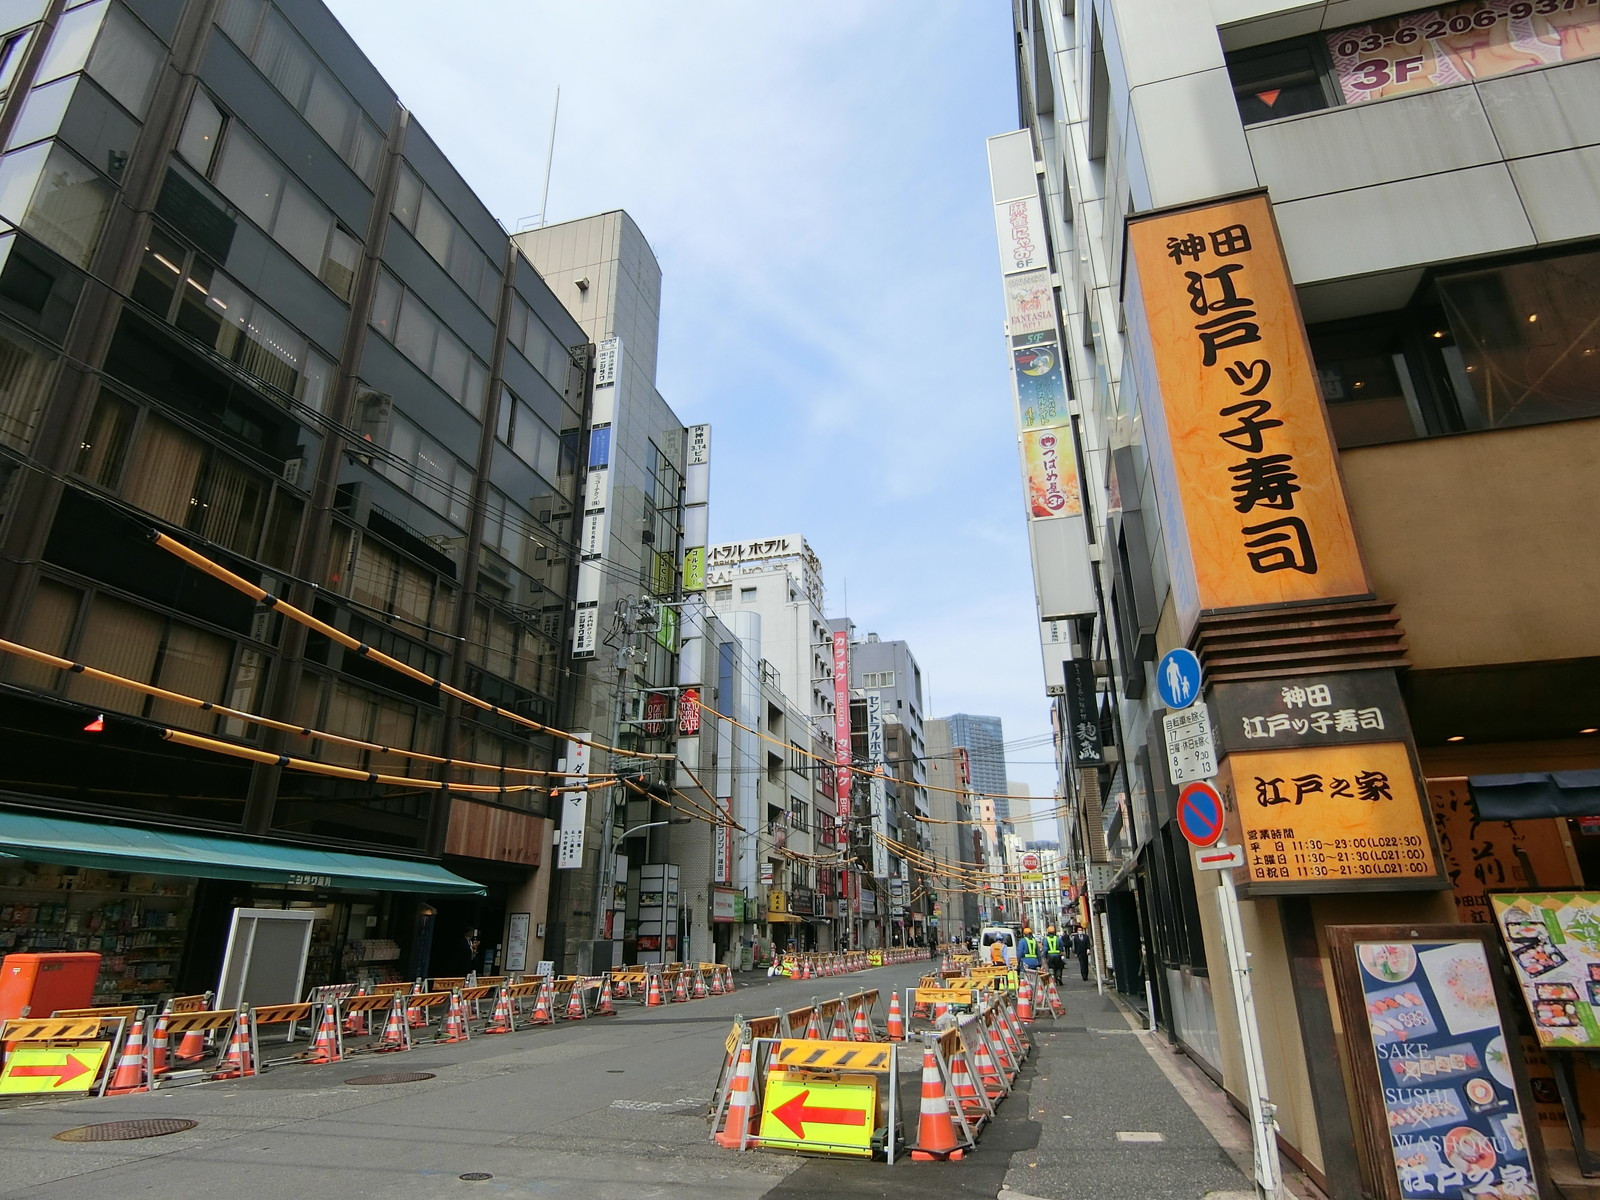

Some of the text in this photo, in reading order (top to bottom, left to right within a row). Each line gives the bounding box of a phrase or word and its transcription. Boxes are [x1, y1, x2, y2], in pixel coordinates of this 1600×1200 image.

[1350, 56, 1425, 91] 3F
[1166, 224, 1252, 265] 神田
[1016, 259, 1034, 269] 6F
[1011, 310, 1052, 324] FANTASIA
[1026, 333, 1044, 345] 5F
[1184, 263, 1318, 575] 江戸ッ子寿司
[1042, 448, 1060, 494] つばめ屋
[1049, 496, 1064, 508] 3F
[749, 539, 790, 556] ホテル
[835, 637, 846, 681] カラオケ
[1281, 683, 1332, 709] 神田
[680, 720, 699, 731] CAFE
[1242, 707, 1384, 739] 江戸ッ子寿司
[1169, 731, 1177, 741] 17
[1199, 722, 1204, 733] 5
[1174, 756, 1178, 766] 8
[1174, 768, 1183, 779] 12
[1202, 762, 1211, 773] 13
[1247, 828, 1295, 840] 営業時間
[1253, 854, 1287, 866] 土曜日
[1256, 866, 1290, 879] 日祝日
[1377, 1043, 1430, 1059] SAKE
[1387, 1088, 1448, 1104] SUSHI
[1394, 1134, 1507, 1154] WASHOKU
